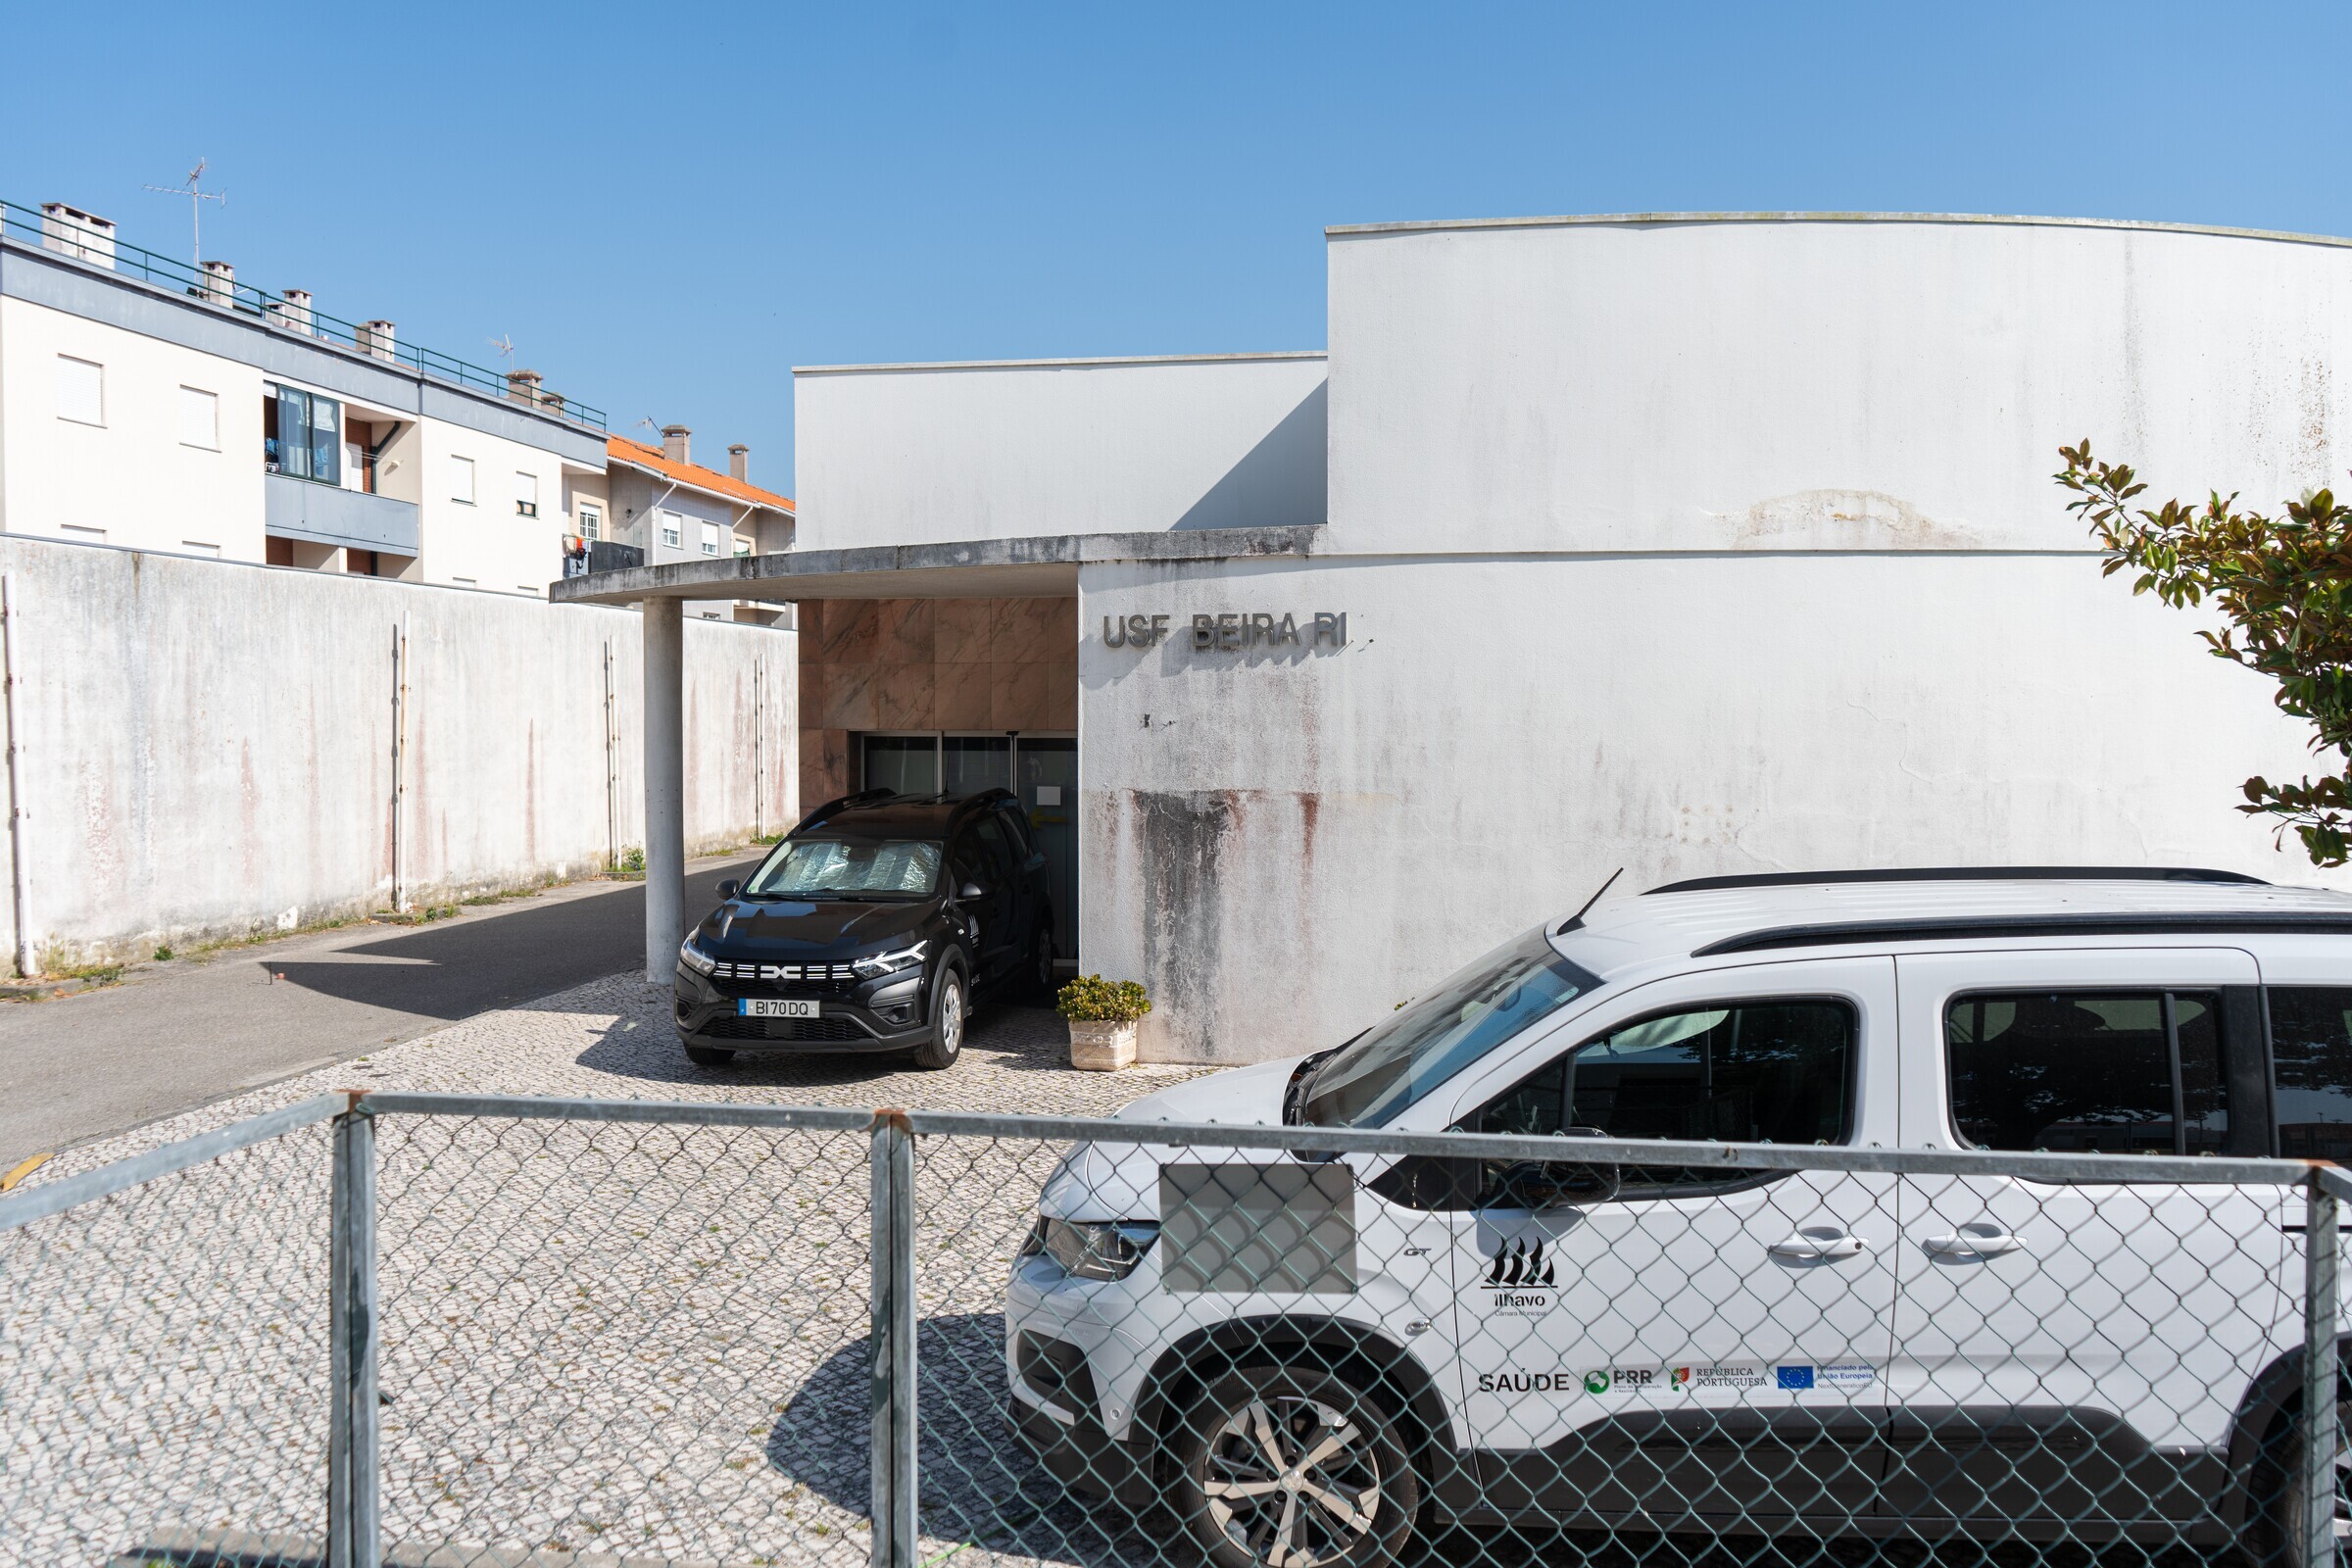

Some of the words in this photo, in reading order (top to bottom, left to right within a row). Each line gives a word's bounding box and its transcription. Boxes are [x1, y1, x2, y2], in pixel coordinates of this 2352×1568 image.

[1103, 614, 1170, 648] USF
[1192, 612, 1301, 647] BEIRA
[1314, 612, 1347, 646] RI
[1403, 1248, 1432, 1256] GT
[1478, 1367, 1570, 1393] SAÚDE
[1613, 1369, 1653, 1385] PRR
[1696, 1377, 1768, 1387] PORTUGUESA
